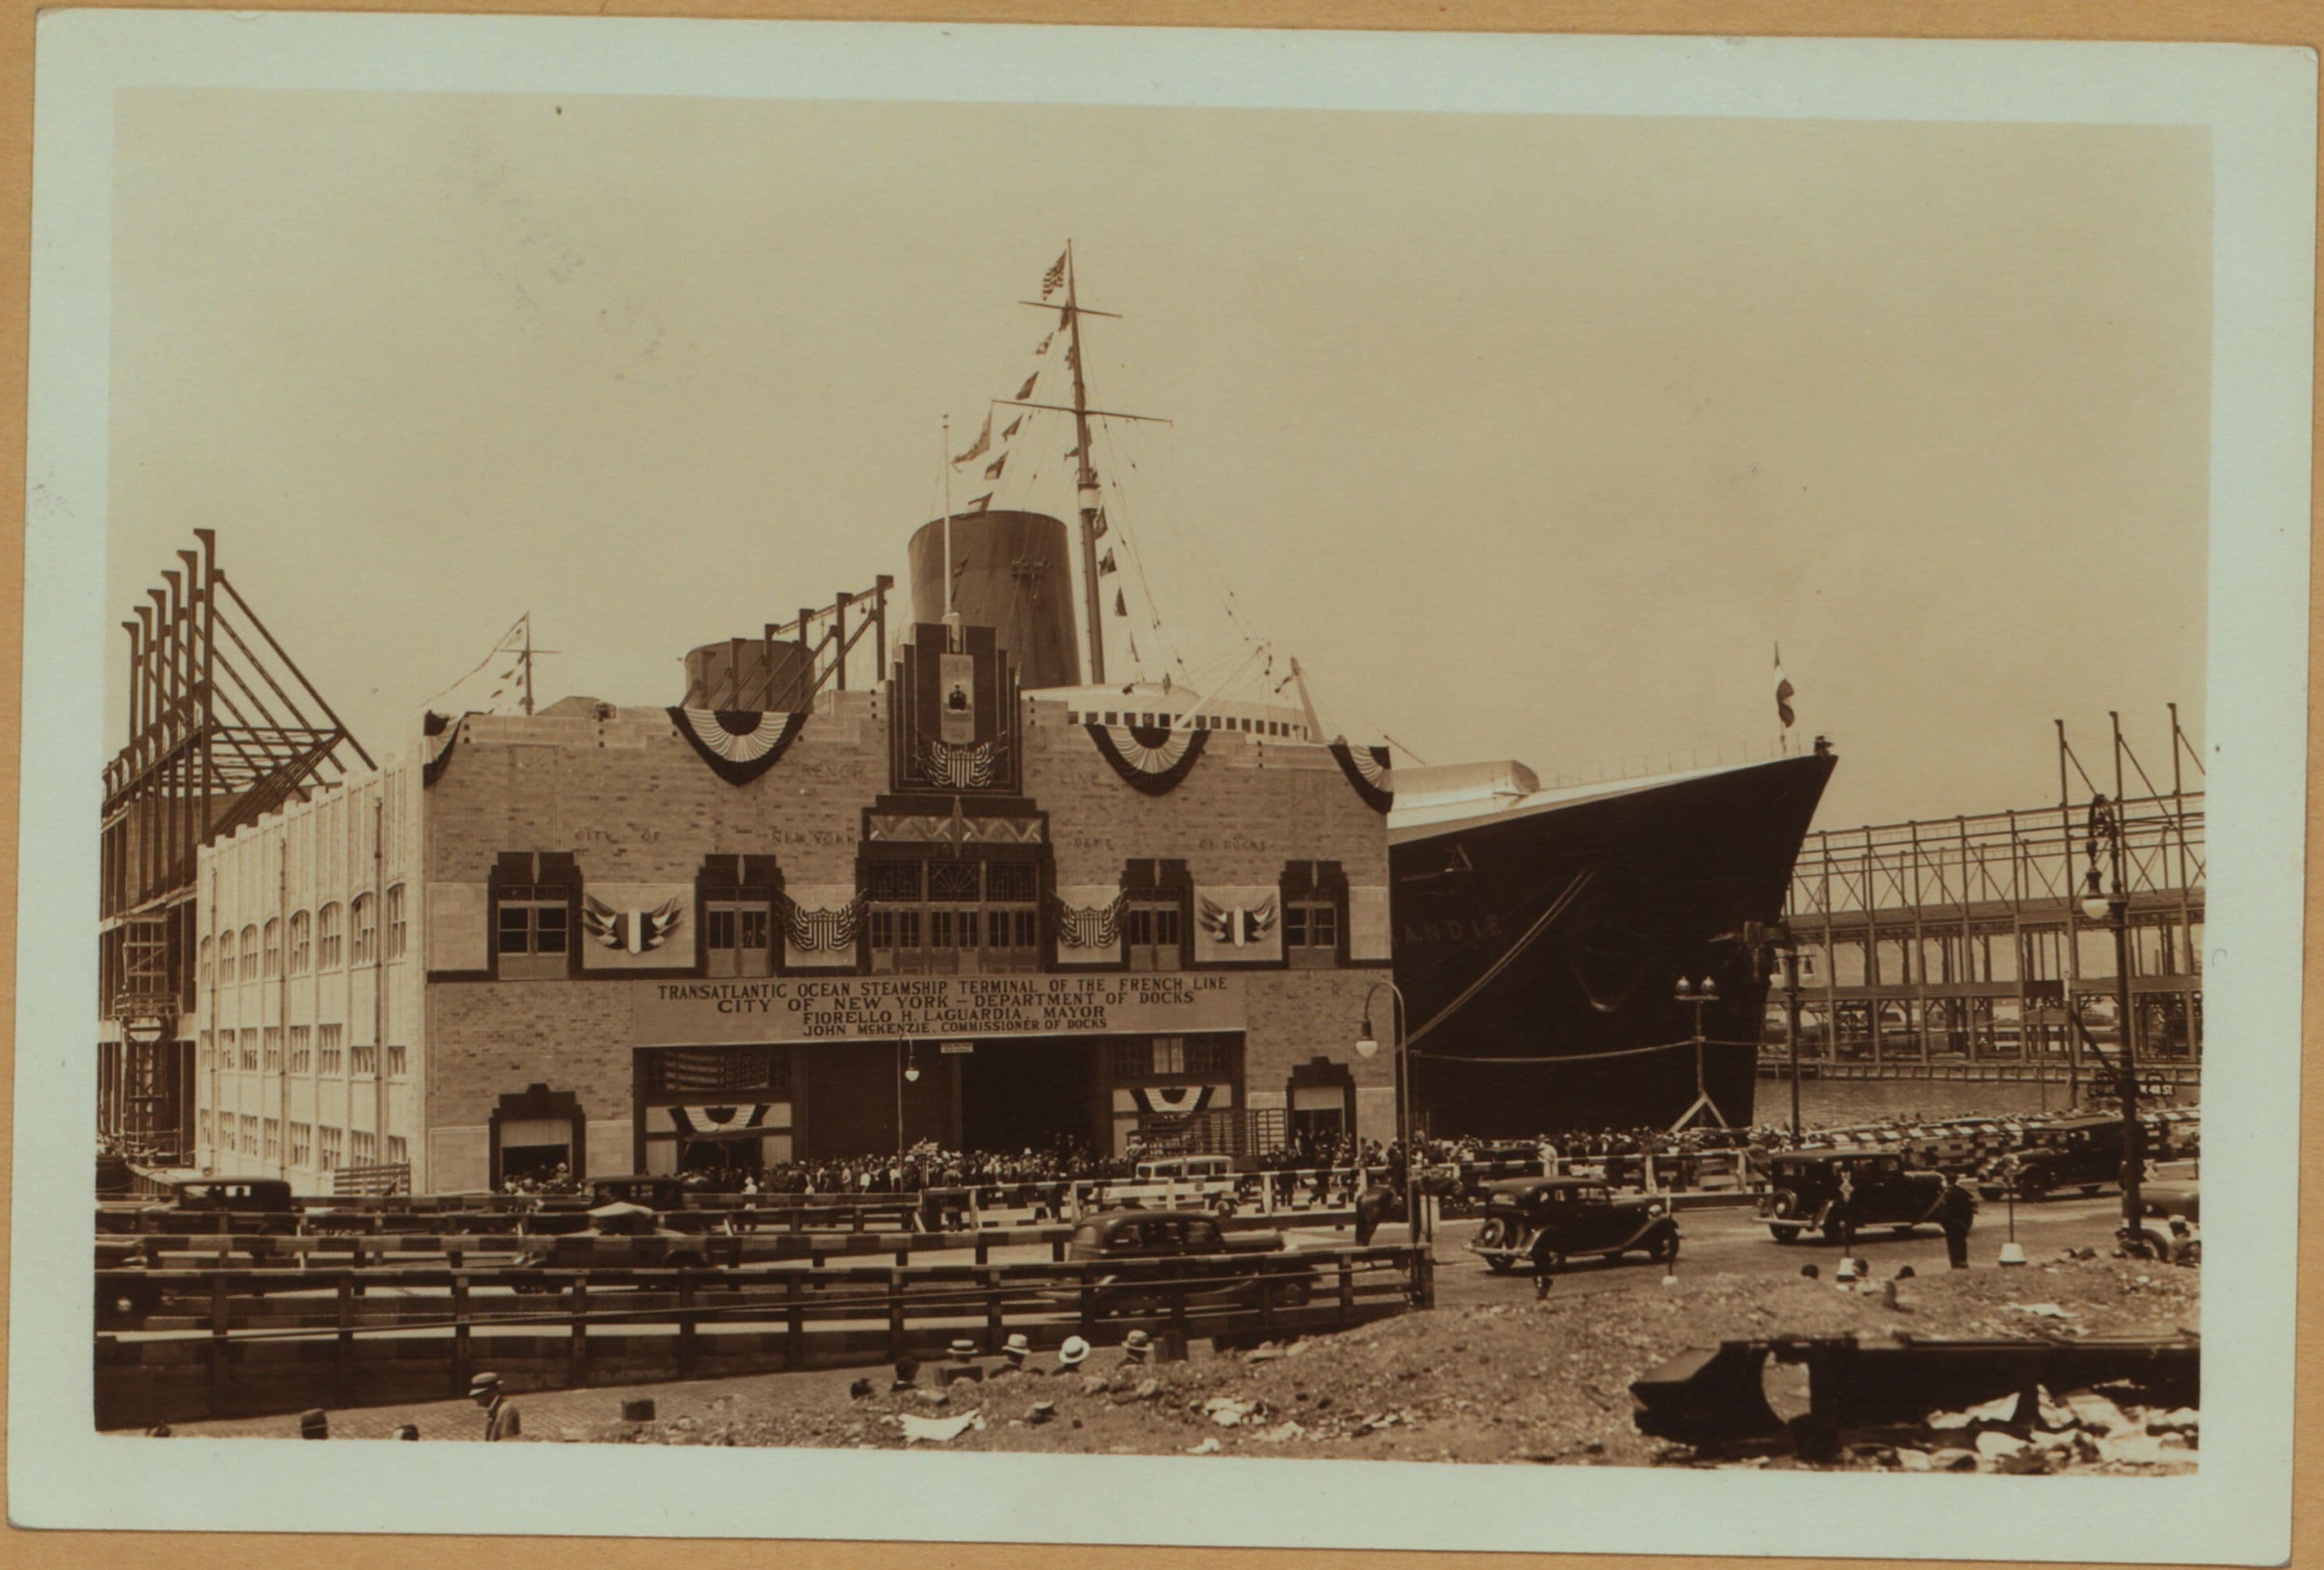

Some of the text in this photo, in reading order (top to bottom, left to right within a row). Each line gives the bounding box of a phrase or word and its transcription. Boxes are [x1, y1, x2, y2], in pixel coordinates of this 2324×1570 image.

[657, 977, 1227, 1000] TRANSATLANTIC OCEAN STEAMSHIP TERMINAL OF THE FRENCH LINE
[717, 999, 771, 1014] CITY
[788, 998, 814, 1012] OF
[834, 997, 881, 1010] NEW
[896, 995, 949, 1009] YORK
[974, 993, 1095, 1007] DEPARTMENT
[1106, 992, 1128, 1005] OF
[1139, 991, 1195, 1004] DOCKS
[803, 1010, 892, 1025] FIORELLO
[901, 1009, 917, 1022] H.
[1044, 1005, 1104, 1019] MAYOR
[803, 1024, 846, 1036] JOHN
[941, 1019, 1039, 1033] COMMISSIONER
[1046, 1019, 1060, 1029] OF
[1067, 1018, 1107, 1029] DOCKS
